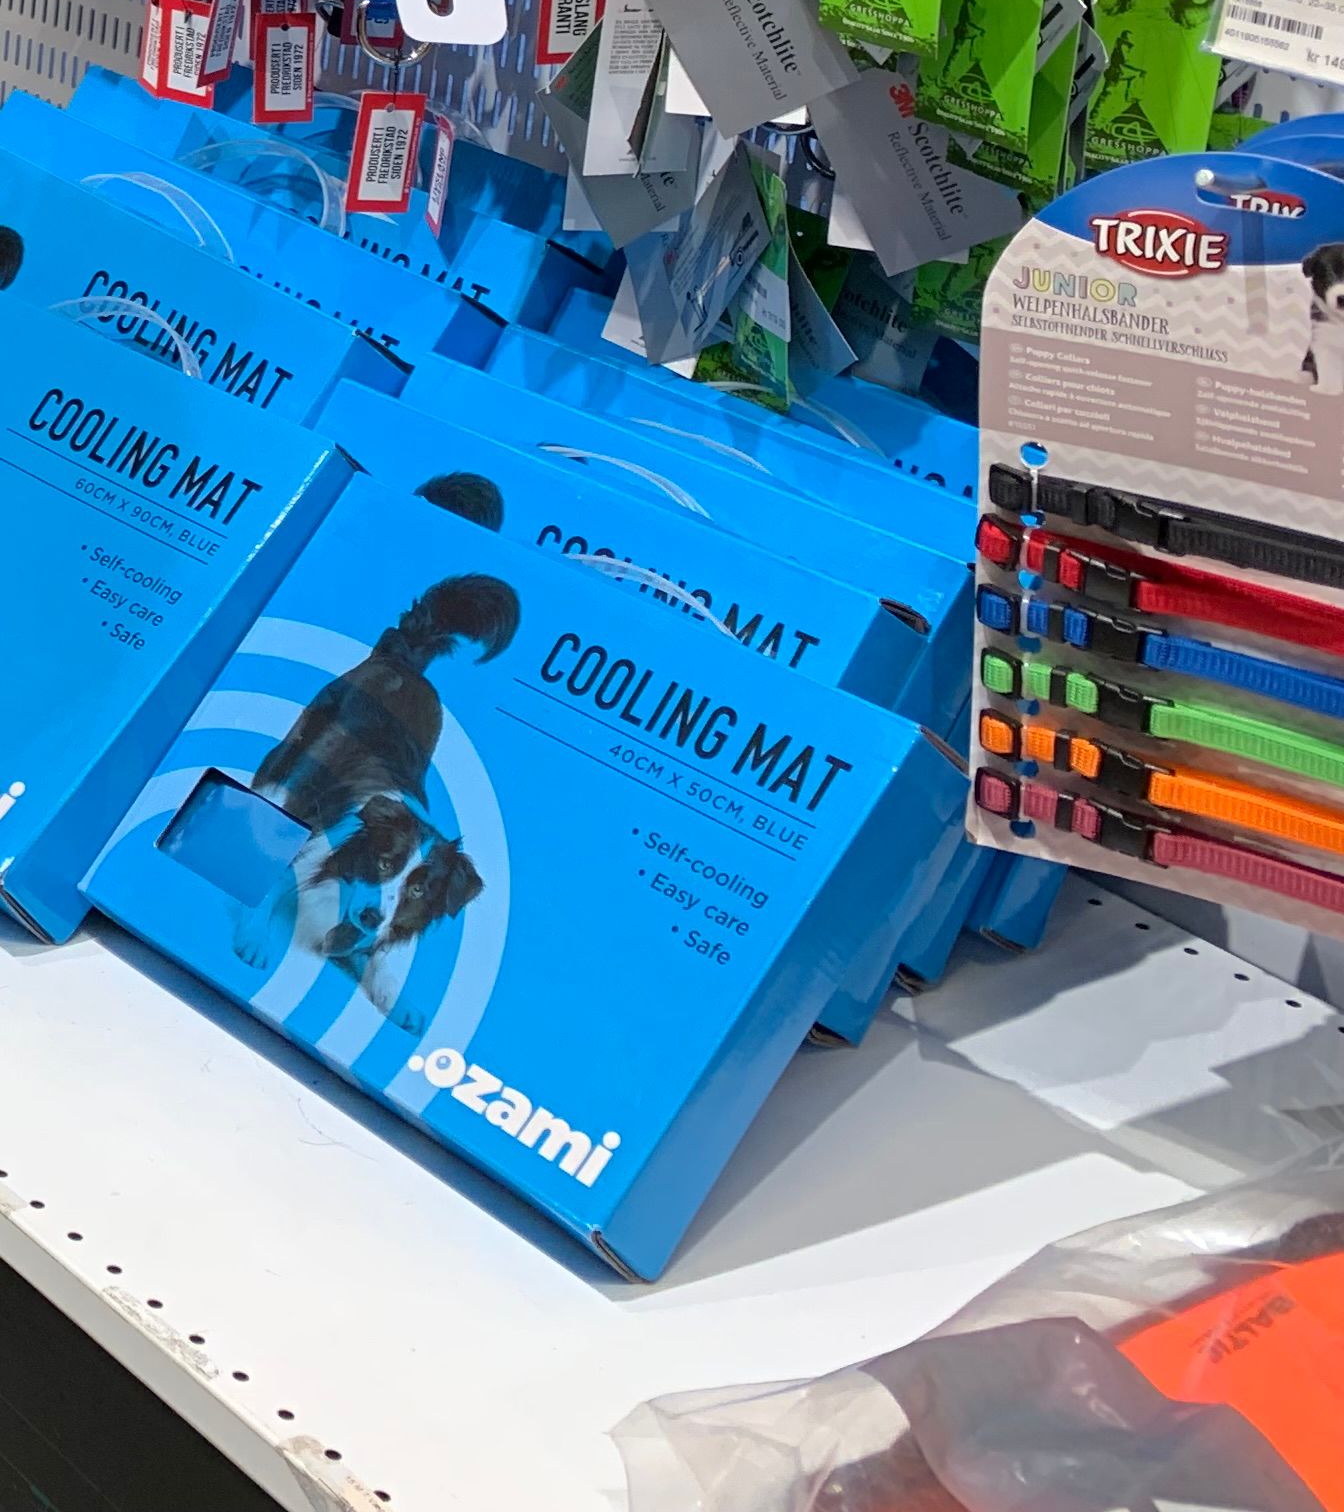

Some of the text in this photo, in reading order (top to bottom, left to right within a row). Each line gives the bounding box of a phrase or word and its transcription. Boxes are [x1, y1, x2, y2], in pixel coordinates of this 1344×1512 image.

[849, 3, 913, 29] GRESSHOPPA
[174, 31, 184, 76] PRODUSERT
[183, 27, 196, 79] FREDRIKSTAD
[270, 47, 281, 95] PRODUSERT
[281, 41, 292, 95] FREDRIKSTAD
[293, 44, 304, 91] SIDEN 1972
[752, 50, 788, 102] Material
[1306, 51, 1318, 63] kr
[889, 83, 916, 119] 3M
[943, 94, 1004, 121] GRESSHOPPA
[366, 133, 383, 183] PRODUSERT
[378, 126, 397, 184] FREDRIKSTAD
[391, 129, 409, 180] SIDEN 1972
[908, 122, 965, 216] Scotchlite
[888, 131, 952, 242] Reflective Material
[1091, 216, 1226, 270] TRIXIE
[1012, 265, 1138, 308] JUNIOR
[209, 341, 295, 411] MAT
[27, 388, 264, 526] COOLING MAT
[75, 477, 221, 557] 60CM X 90CM, BLUE
[89, 546, 184, 606] Self-cooling
[90, 579, 164, 627] Easy care
[109, 622, 146, 651] Safe
[721, 602, 821, 670] MAT
[540, 632, 854, 813] COOLING MAT
[608, 743, 809, 851] 40CM X 50CM, BLUE
[643, 831, 770, 910] Self-cooling
[650, 871, 751, 937] Easy care
[683, 929, 732, 966] Safe
